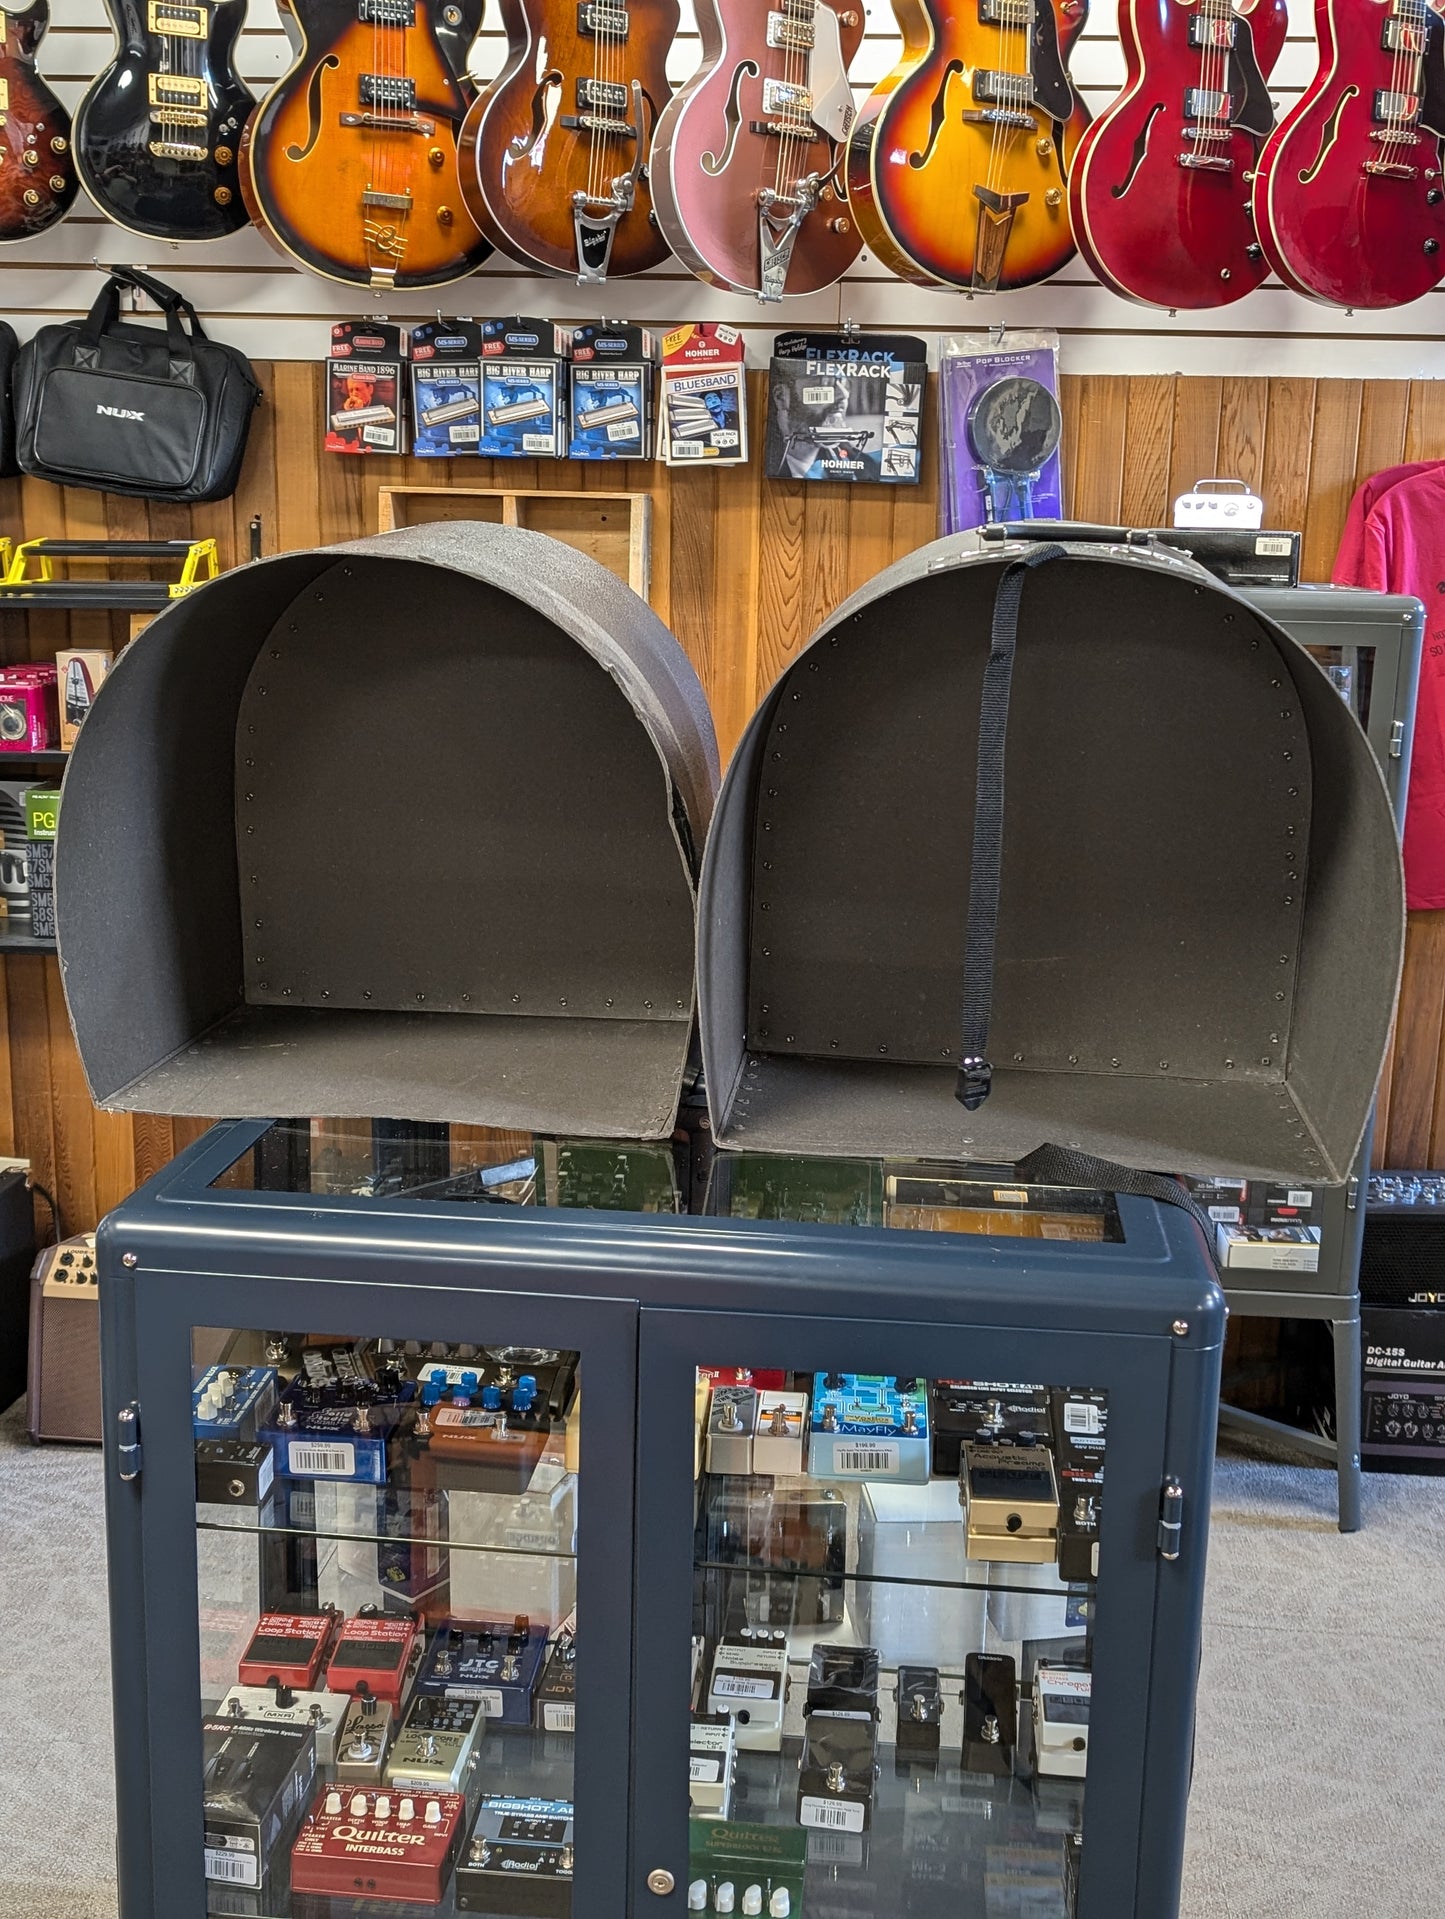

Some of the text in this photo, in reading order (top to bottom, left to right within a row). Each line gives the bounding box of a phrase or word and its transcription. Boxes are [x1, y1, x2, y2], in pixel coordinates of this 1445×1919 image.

[841, 104, 853, 137] GRETSCH
[333, 343, 348, 352] FREE
[414, 347, 432, 355] FREE
[484, 342, 502, 351] FREE
[574, 349, 591, 358] FREE
[685, 349, 720, 357] HOHNER
[994, 355, 1031, 363] BLOCKER
[333, 363, 395, 375] MARINE BAND 1896
[417, 368, 430, 378] BIG
[433, 368, 456, 377] RIVER
[486, 365, 552, 377] BIG RIVER HARP
[806, 361, 891, 379] FLEXRACK
[576, 370, 640, 381] BIG RIVER HARP
[674, 374, 736, 392] BLUESBAND
[821, 459, 865, 470] HOHNER
[33, 811, 55, 829] PG
[28, 874, 53, 888] SM5
[31, 892, 54, 907] SM5
[32, 907, 54, 922] 58S
[34, 922, 55, 937] SM5
[1367, 1346, 1405, 1356] DC-15S
[1366, 1357, 1436, 1369] Digital Guitar
[842, 1424, 896, 1436] MayFly
[258, 1626, 321, 1636] Loop Station
[461, 1659, 499, 1668] JTC
[1047, 1679, 1091, 1687] Chroma
[403, 1757, 445, 1766] NUX
[488, 1802, 551, 1812] BIGSHOT
[330, 1825, 426, 1846] Quilter
[345, 1843, 405, 1856] INTERBASS
